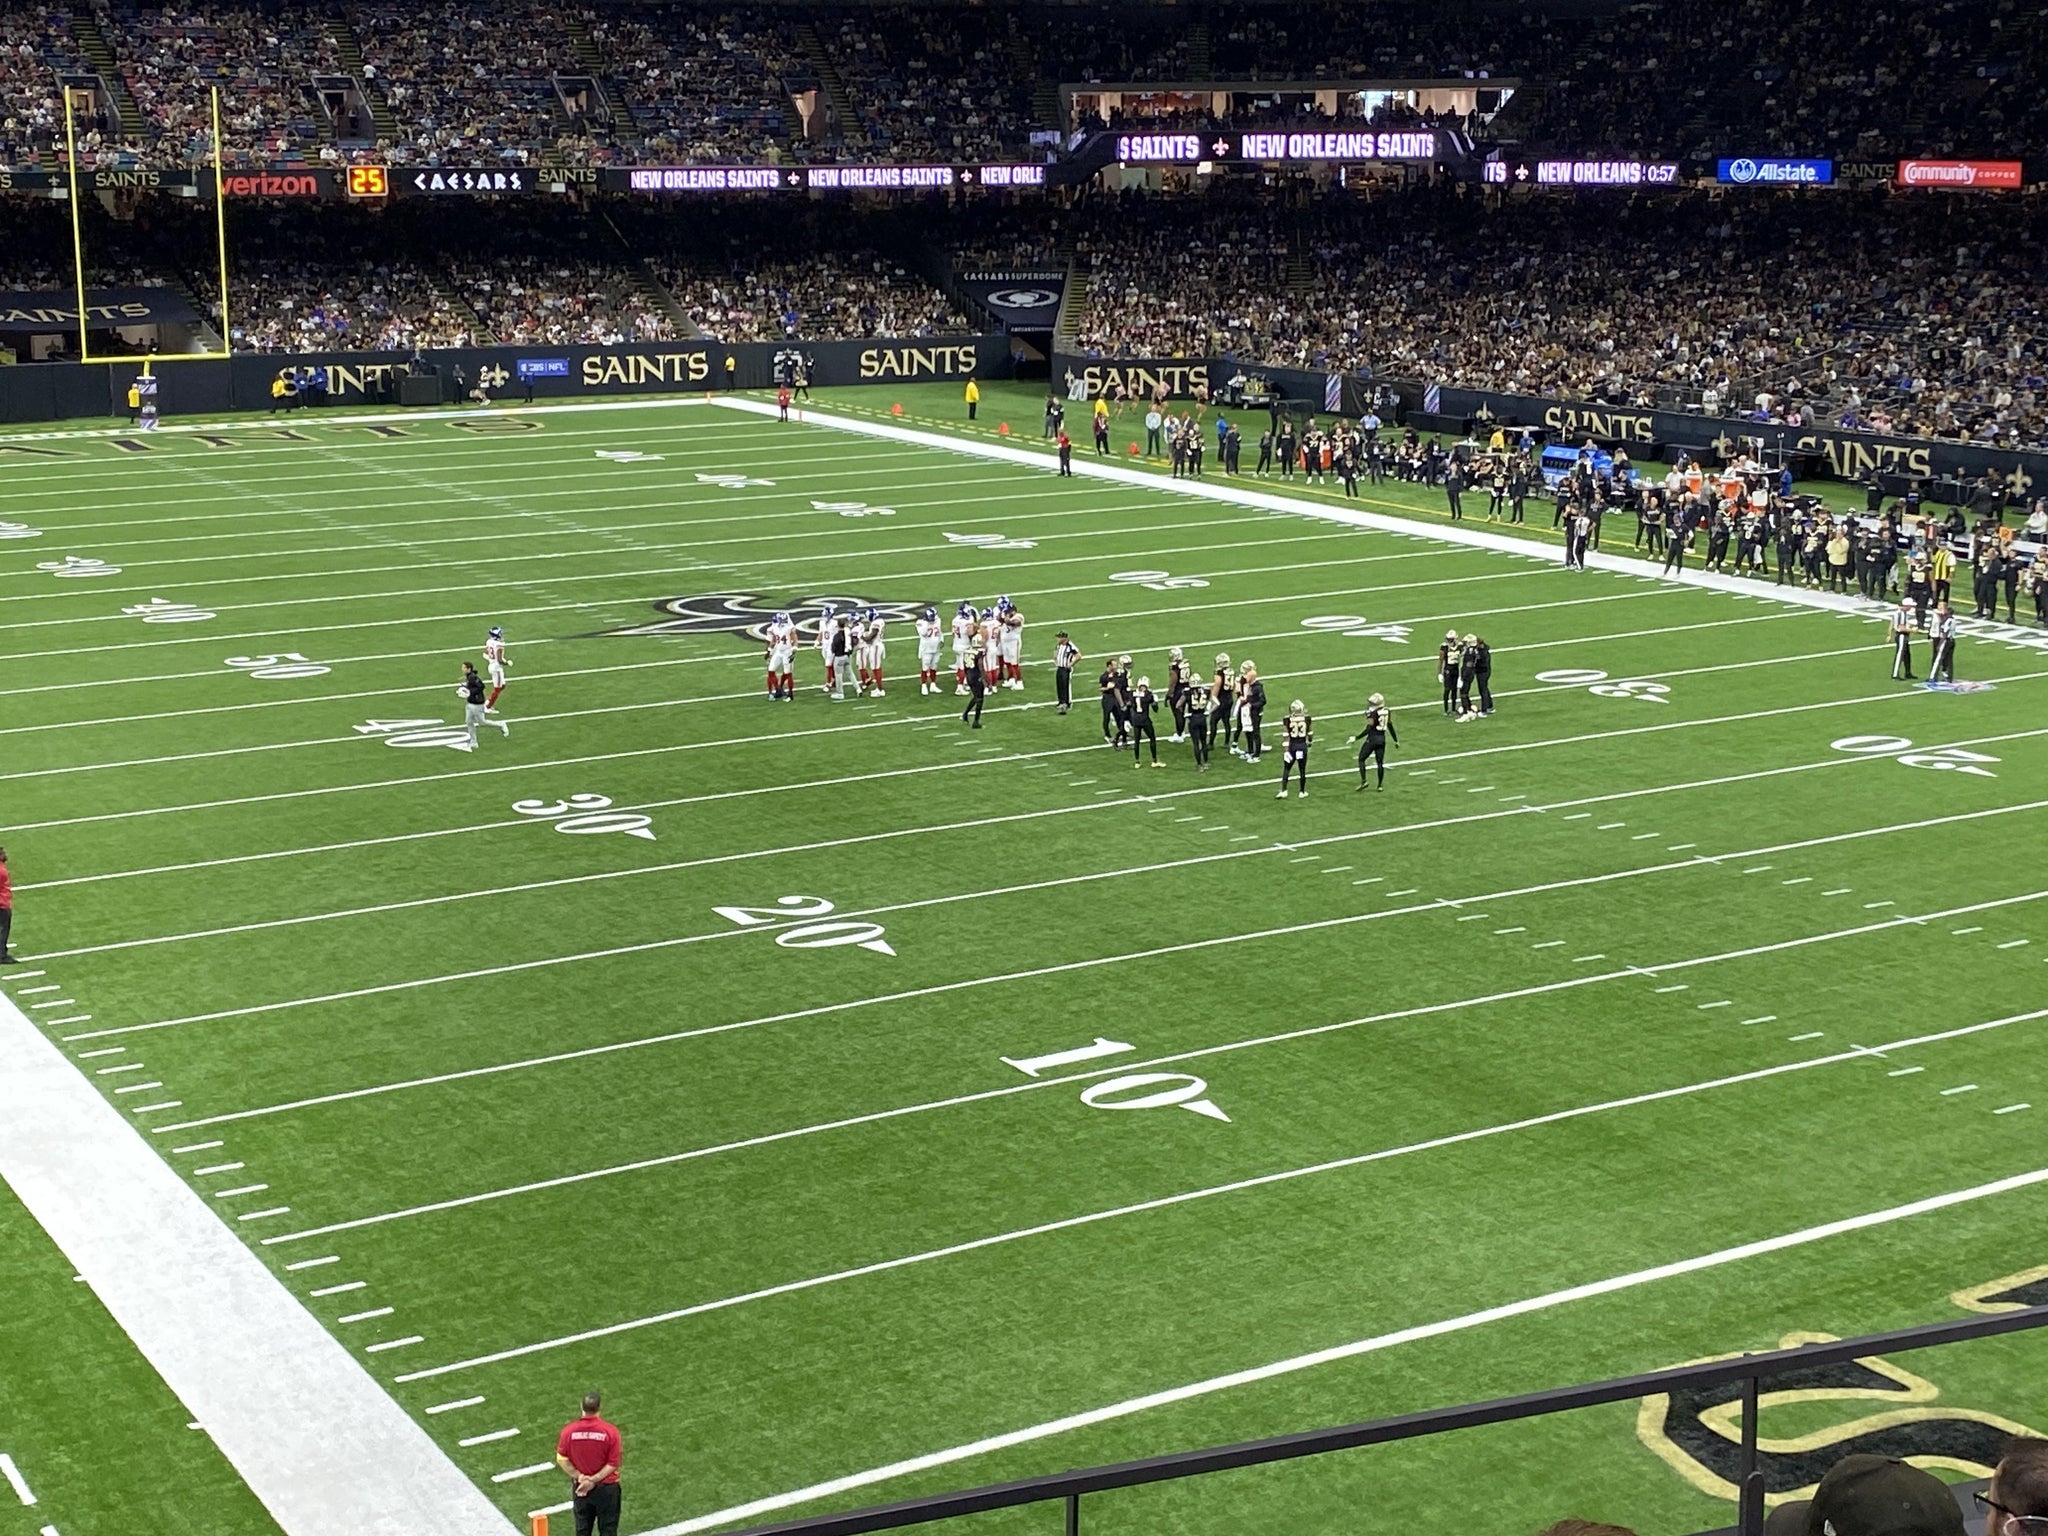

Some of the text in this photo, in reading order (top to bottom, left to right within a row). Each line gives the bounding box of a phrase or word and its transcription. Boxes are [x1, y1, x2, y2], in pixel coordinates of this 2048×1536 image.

[1131, 135, 1200, 160] SAINTS
[1242, 134, 1287, 158] NEW
[1289, 133, 1375, 158] ORLEANS
[1377, 132, 1434, 157] SAINTS
[95, 171, 161, 187] SAINTS
[353, 169, 383, 193] 25
[538, 168, 597, 183] SAINTS
[631, 169, 779, 189] NEW ORLEANS SAINTS
[808, 167, 953, 187] NEW ORLEANS SAINTS
[981, 166, 1011, 185] NEW
[1538, 162, 1642, 182] NEW ORLEANS
[1647, 165, 1676, 181] 0:57
[1756, 162, 1818, 181] Allstate
[1840, 163, 1895, 178] SAINTS
[1904, 162, 2016, 185] Community COFFEE
[414, 172, 521, 191] CAESARS
[963, 272, 1010, 280] CAESARS
[583, 350, 709, 386] SAINTS
[860, 345, 978, 378] SAINTS
[224, 652, 332, 679] 50
[1534, 668, 1672, 698] 30
[352, 718, 472, 747] 40
[1290, 721, 1307, 738] 33
[1830, 735, 2003, 770] 20
[512, 793, 652, 834] 30
[711, 895, 885, 948] 20
[1000, 1037, 1207, 1110] 10
